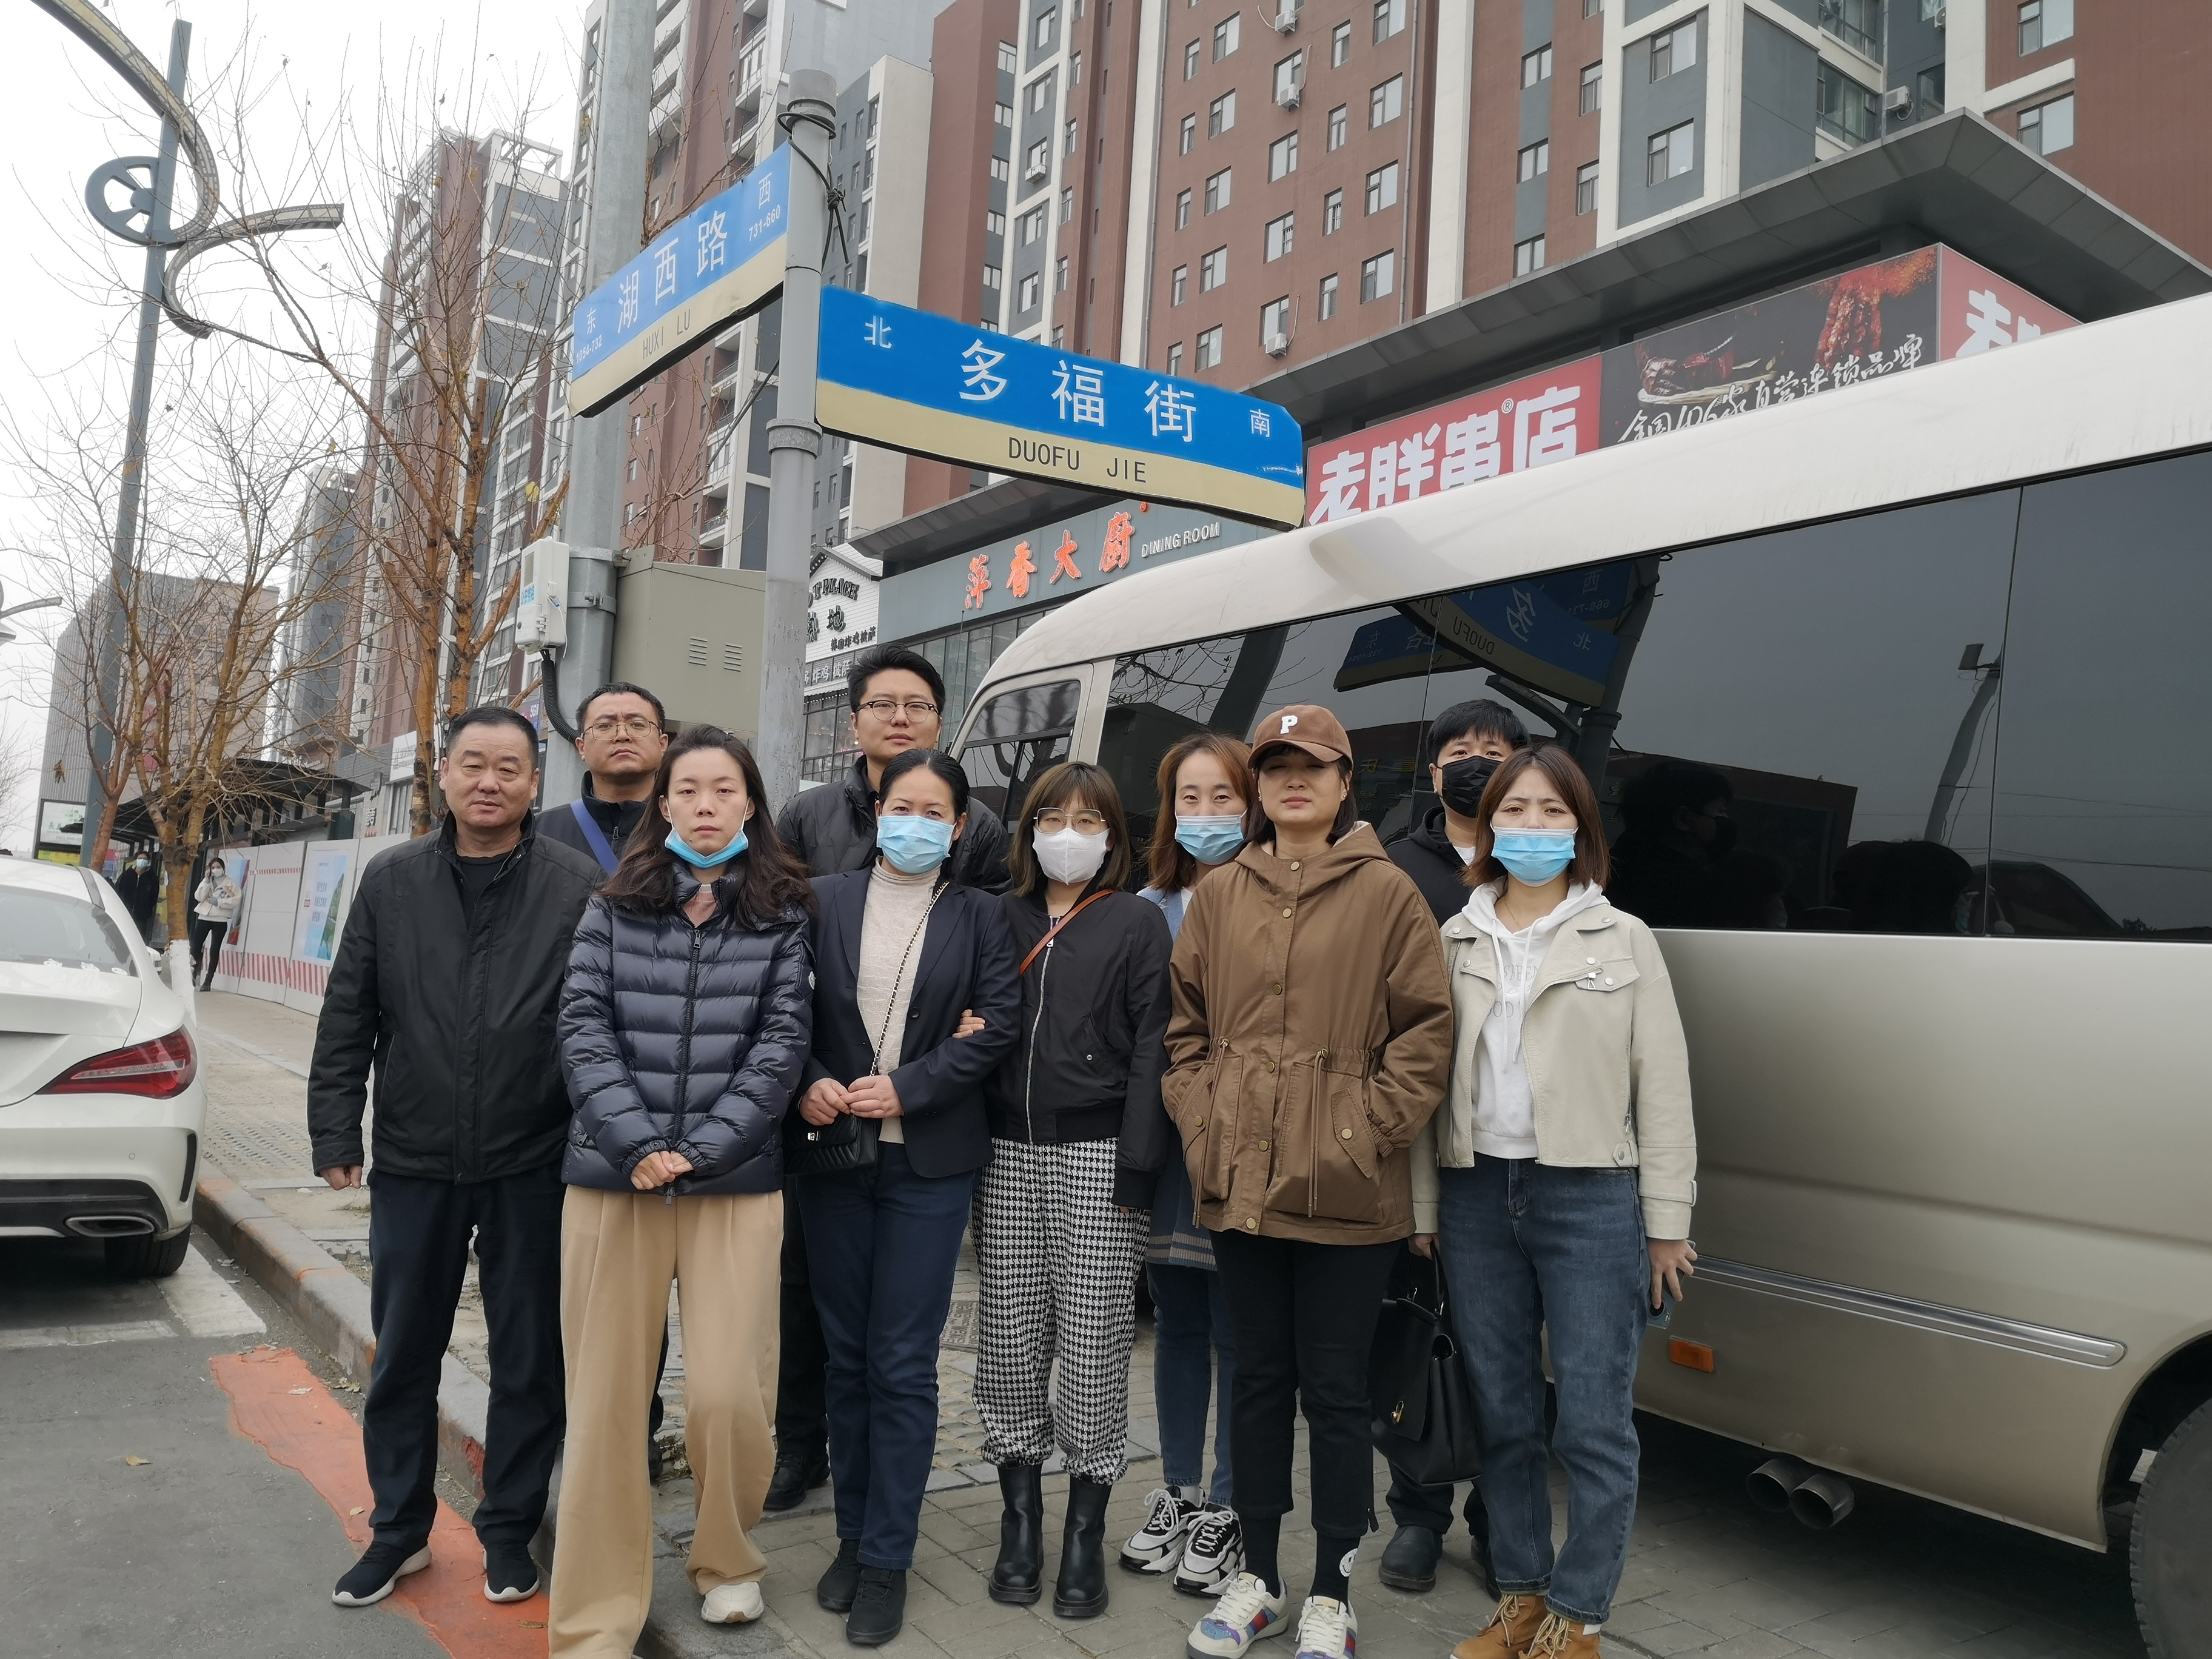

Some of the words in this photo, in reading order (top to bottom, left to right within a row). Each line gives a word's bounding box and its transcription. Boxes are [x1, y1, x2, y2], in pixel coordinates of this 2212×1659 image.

[759, 172, 773, 210] 西
[748, 204, 780, 242] 731-660
[617, 210, 728, 334] 湖西路
[586, 307, 597, 335] 东
[642, 326, 664, 360] HUXI
[677, 308, 691, 336] LU
[863, 315, 893, 350] 北
[576, 335, 603, 364] 1054-732
[959, 338, 1197, 443] 多福街
[1249, 409, 1272, 438] 南
[1008, 436, 1080, 472] DUOFU
[1106, 457, 1147, 484] JIE
[1141, 533, 1182, 558] DINING
[1183, 521, 1221, 545] ROOM
[1280, 715, 1298, 735] P
